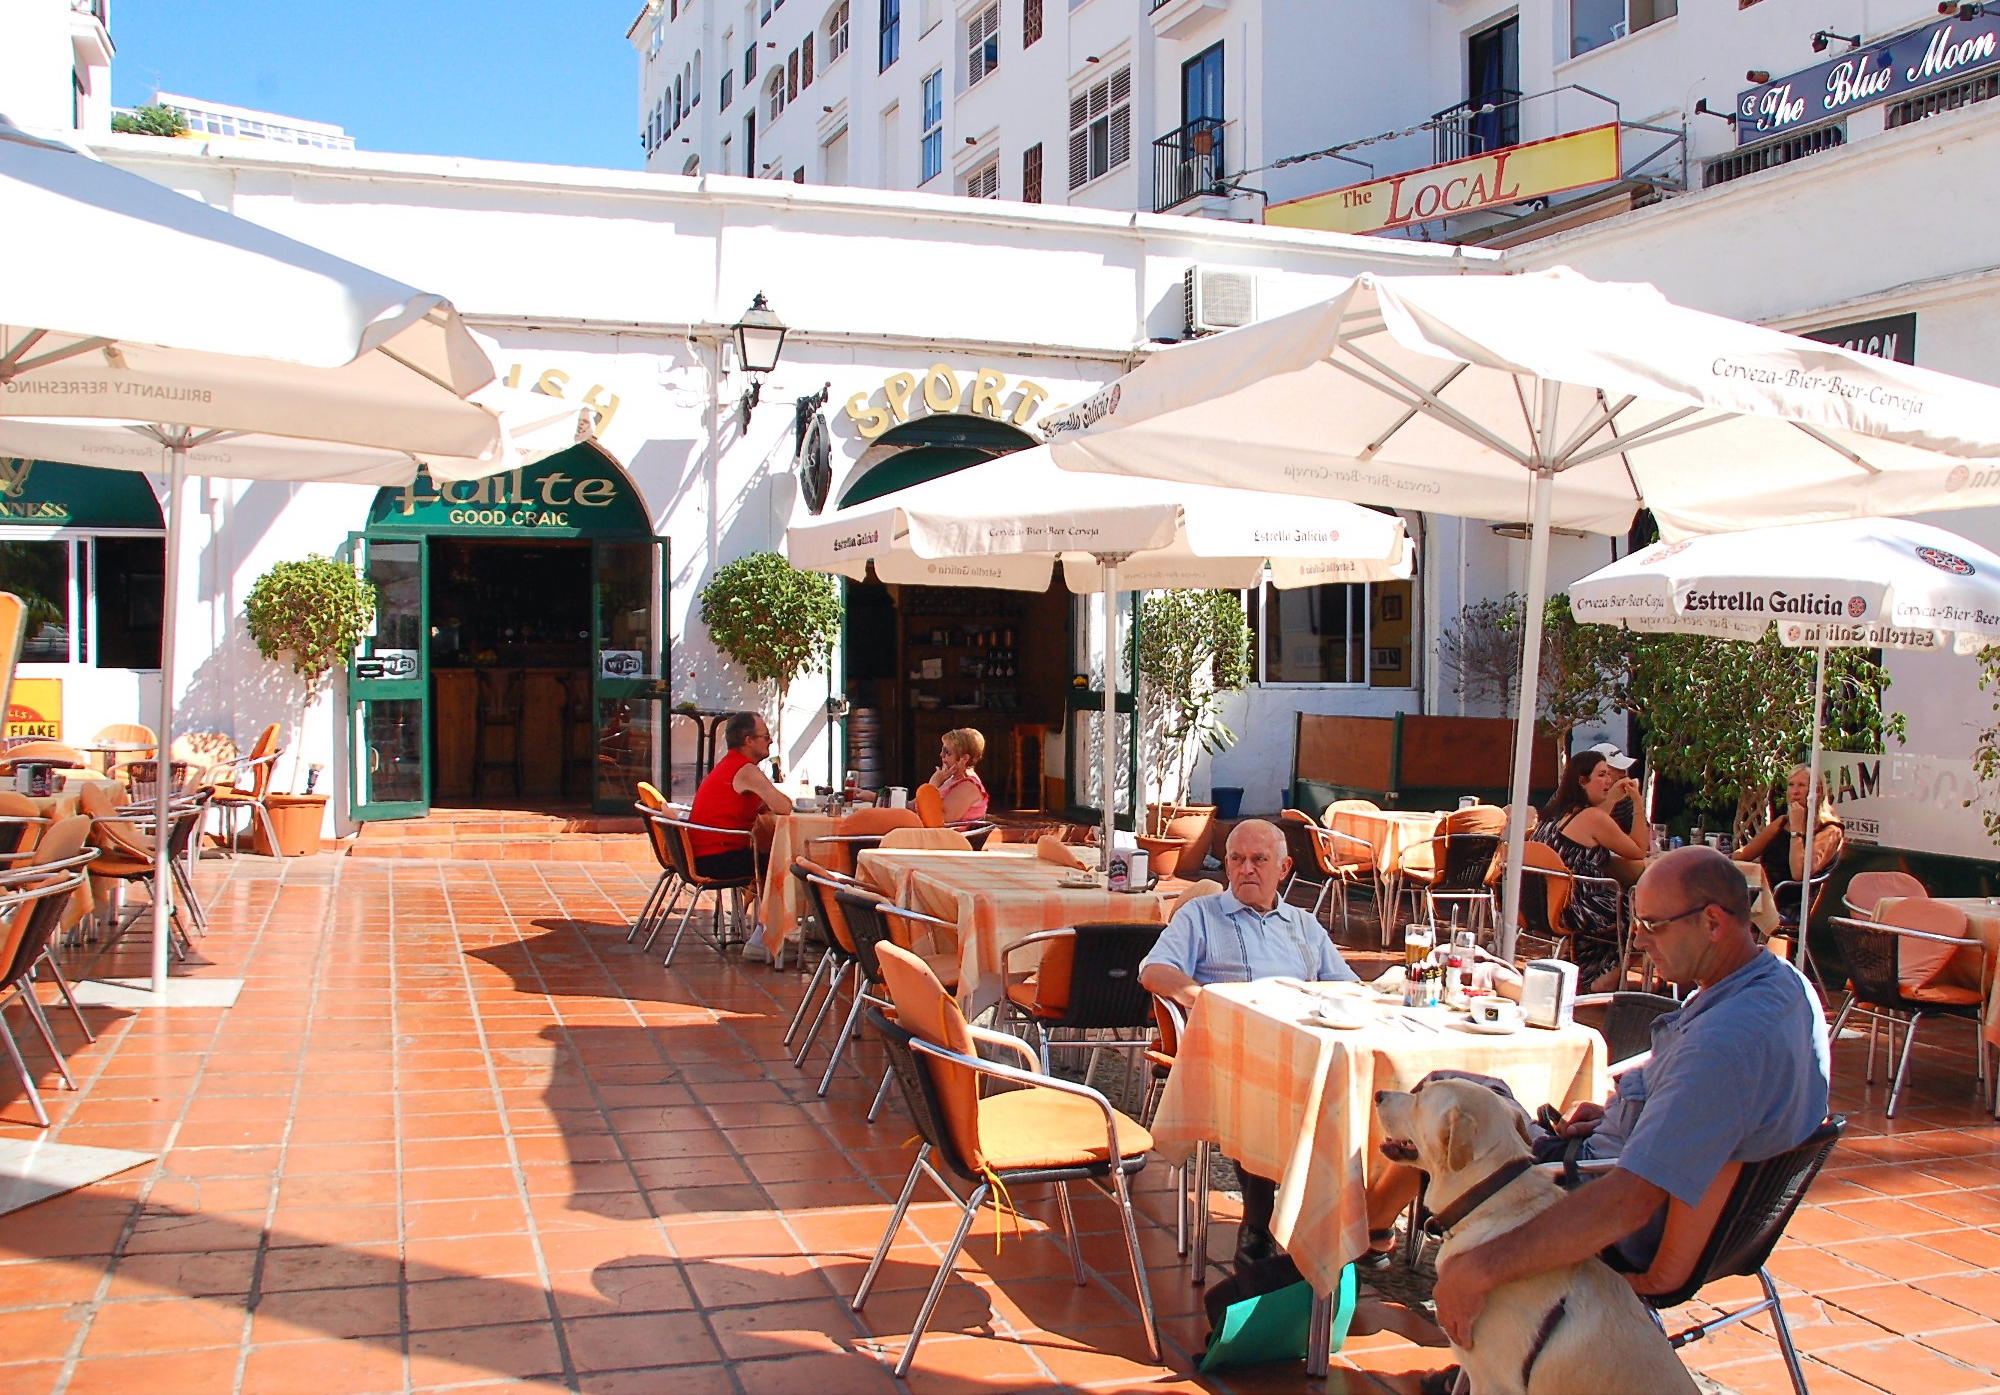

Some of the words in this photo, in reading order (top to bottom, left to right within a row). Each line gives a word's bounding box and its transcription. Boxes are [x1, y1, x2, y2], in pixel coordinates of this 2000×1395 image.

[1757, 83, 1804, 131] The
[1824, 55, 1891, 110] Blue
[1906, 25, 1997, 82] Moon
[1340, 190, 1372, 208] The
[845, 363, 1070, 438] SPORT
[450, 509, 505, 525] GOOD
[512, 511, 568, 526] CRAIC
[1685, 590, 1764, 611] Estrella
[1769, 590, 1842, 616] Galicia
[1841, 820, 1880, 834] RISH
